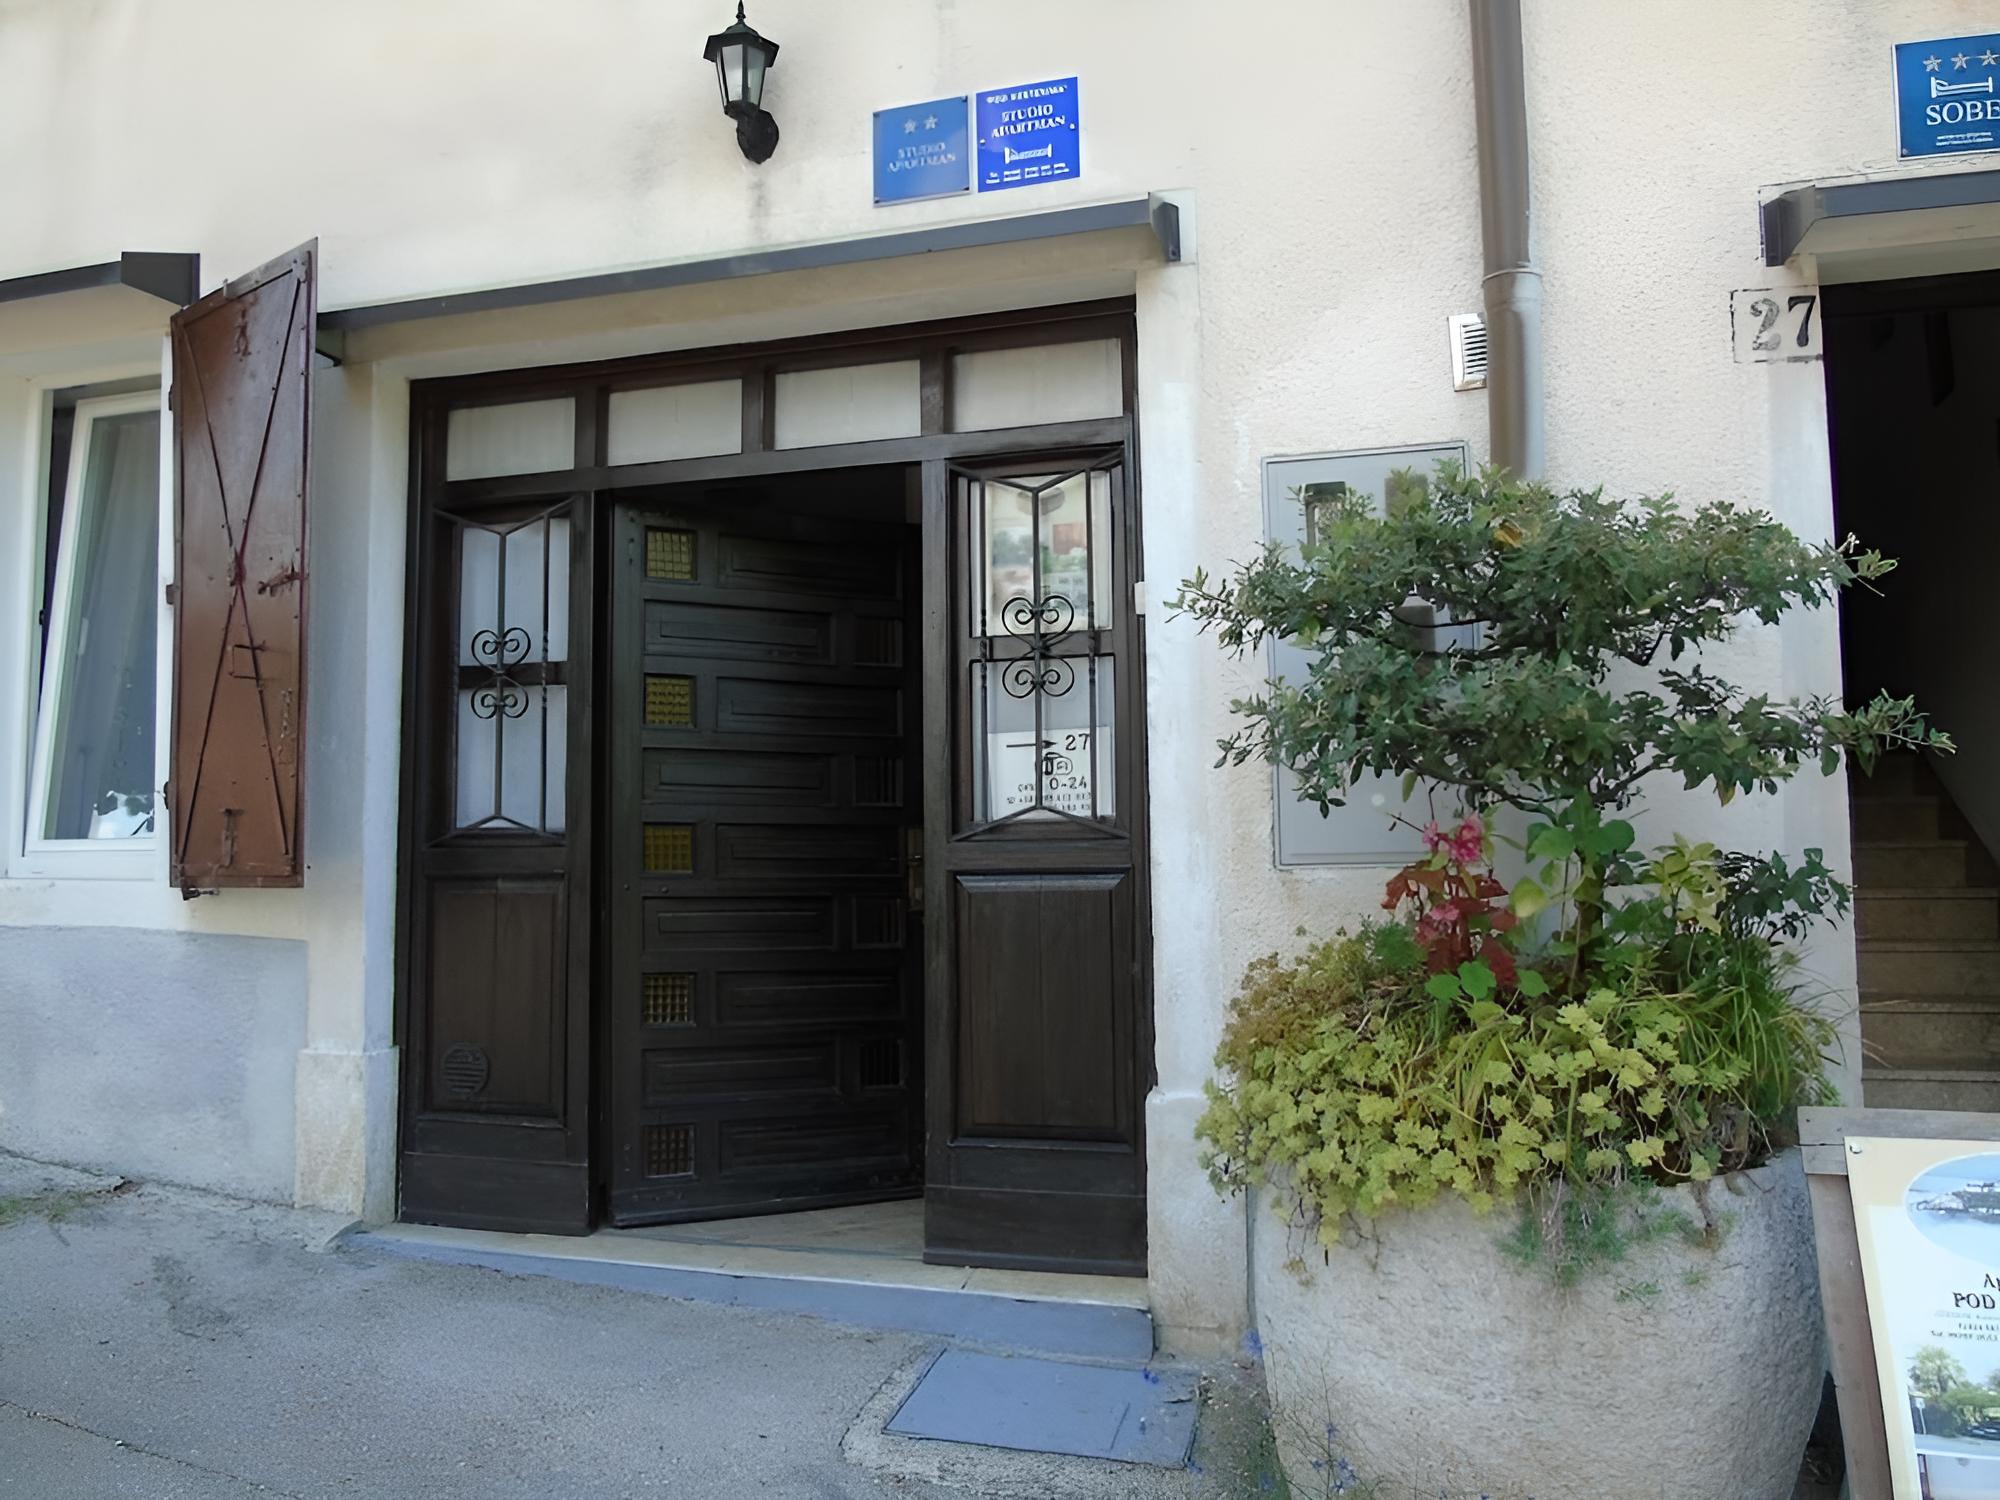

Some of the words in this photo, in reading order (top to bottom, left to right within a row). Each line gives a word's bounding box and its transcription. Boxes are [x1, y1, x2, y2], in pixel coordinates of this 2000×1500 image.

[1001, 103, 1054, 123] STUDIO
[1925, 99, 2000, 126] SOBE
[1749, 295, 1817, 351] 27
[1065, 732, 1090, 751] 27
[1952, 1291, 1996, 1309] POD
